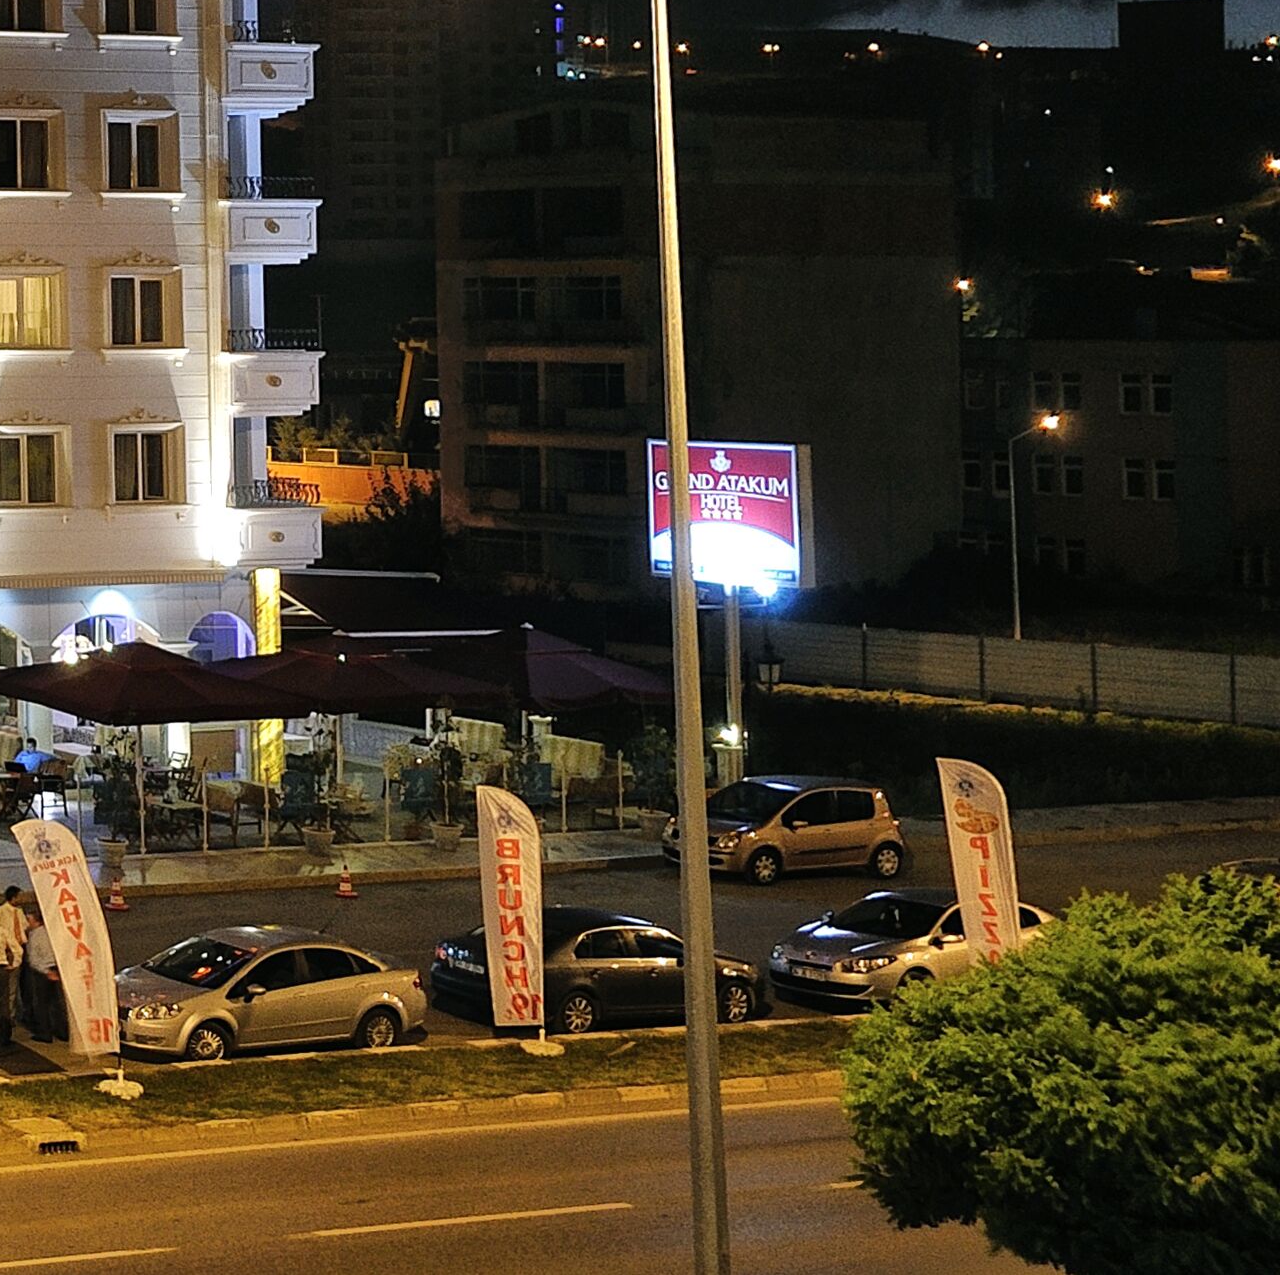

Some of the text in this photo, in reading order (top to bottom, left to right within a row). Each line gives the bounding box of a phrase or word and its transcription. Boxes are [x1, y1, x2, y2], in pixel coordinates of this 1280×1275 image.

[655, 471, 789, 497] GND ATAKUM
[700, 494, 743, 511] HOTEL
